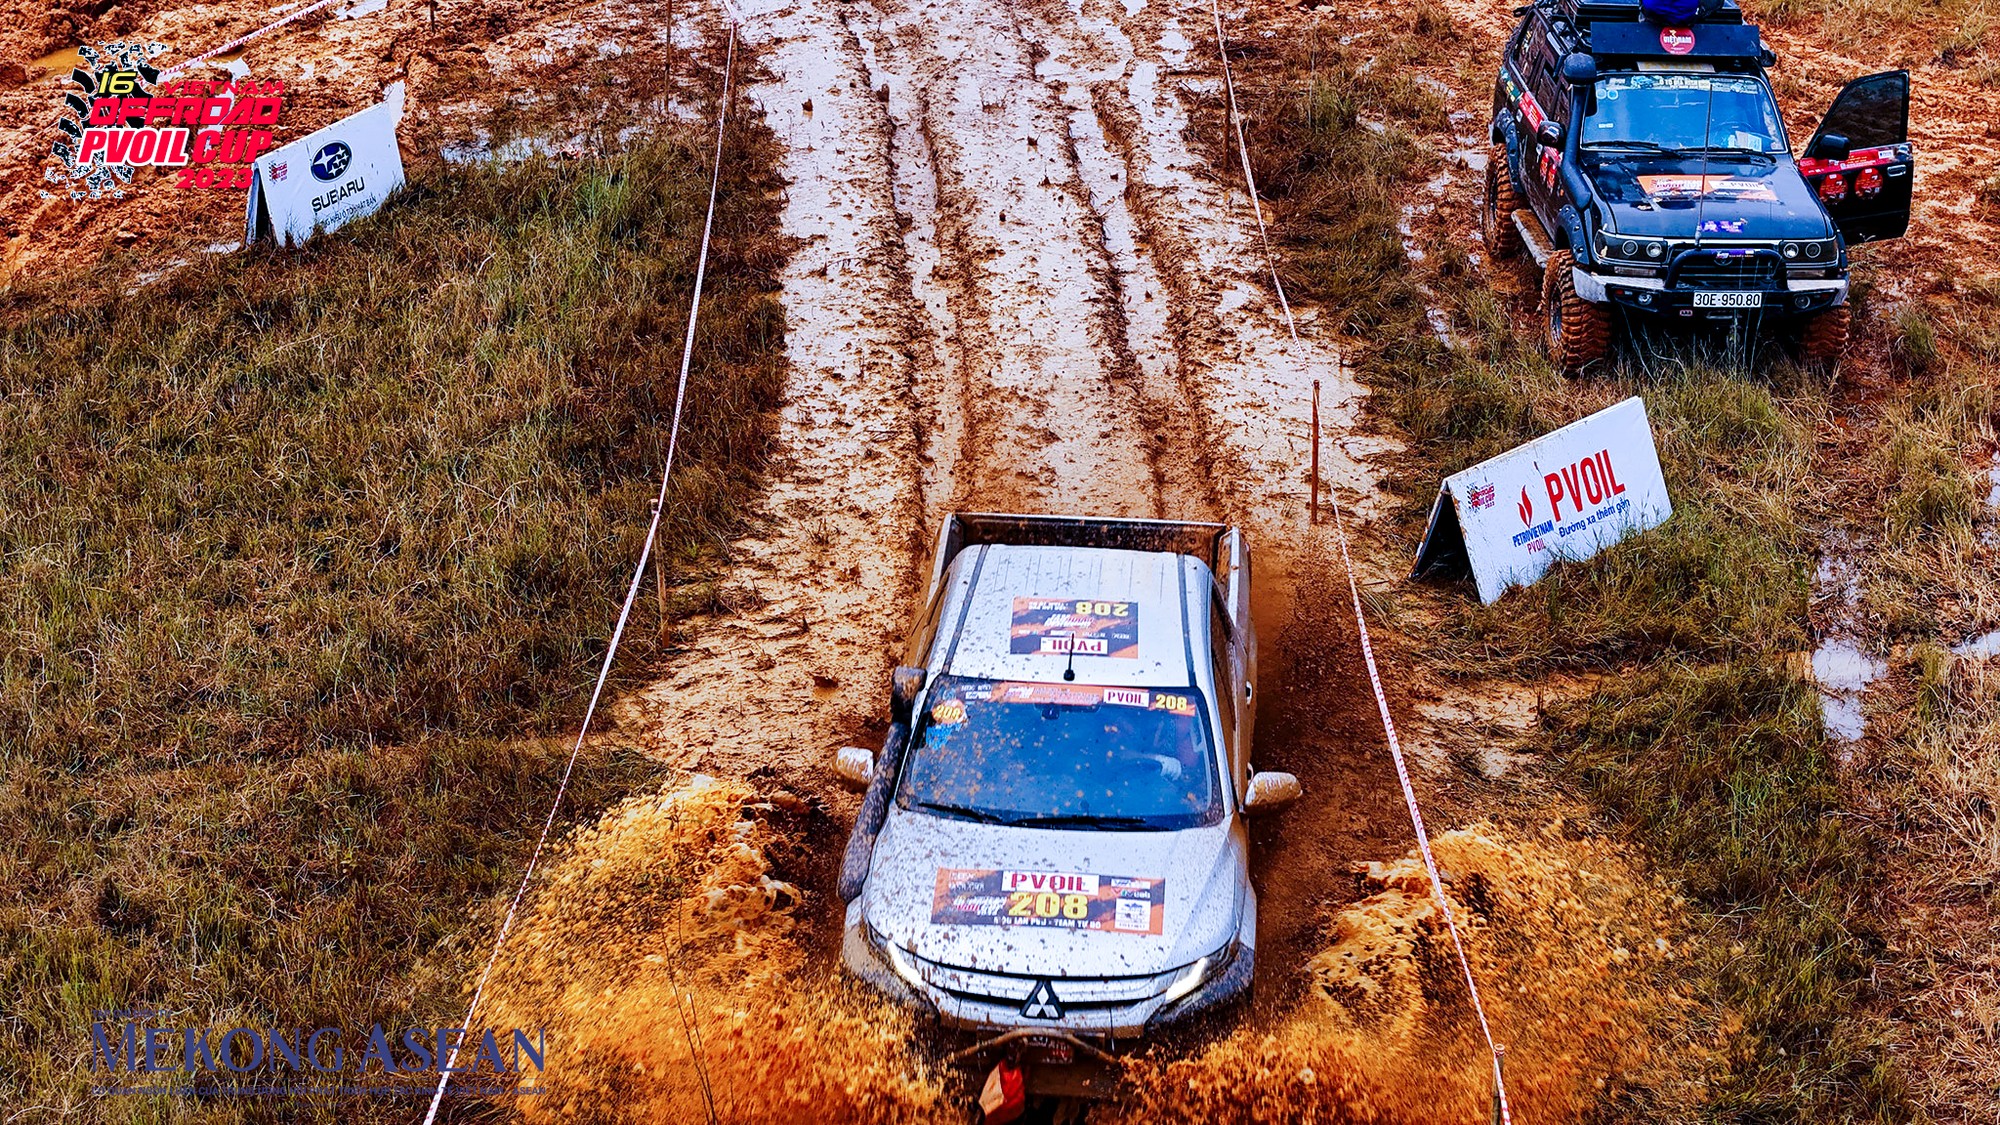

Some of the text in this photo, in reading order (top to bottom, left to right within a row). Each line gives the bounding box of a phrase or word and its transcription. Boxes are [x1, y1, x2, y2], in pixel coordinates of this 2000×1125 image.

[311, 176, 365, 213] SUBARU
[1695, 293, 1761, 306] 30E-950.80
[1544, 449, 1626, 522] PVOIL
[1558, 517, 1587, 539] Đường
[1585, 514, 1596, 526] xa
[1595, 504, 1616, 522] thêm
[1512, 519, 1555, 548] PETROVIETNAM
[1526, 538, 1547, 555] PVOIL
[1075, 601, 1129, 617] 208
[1155, 693, 1188, 711] 208
[1010, 873, 1089, 892] PVOIL
[1008, 892, 1088, 919] 208
